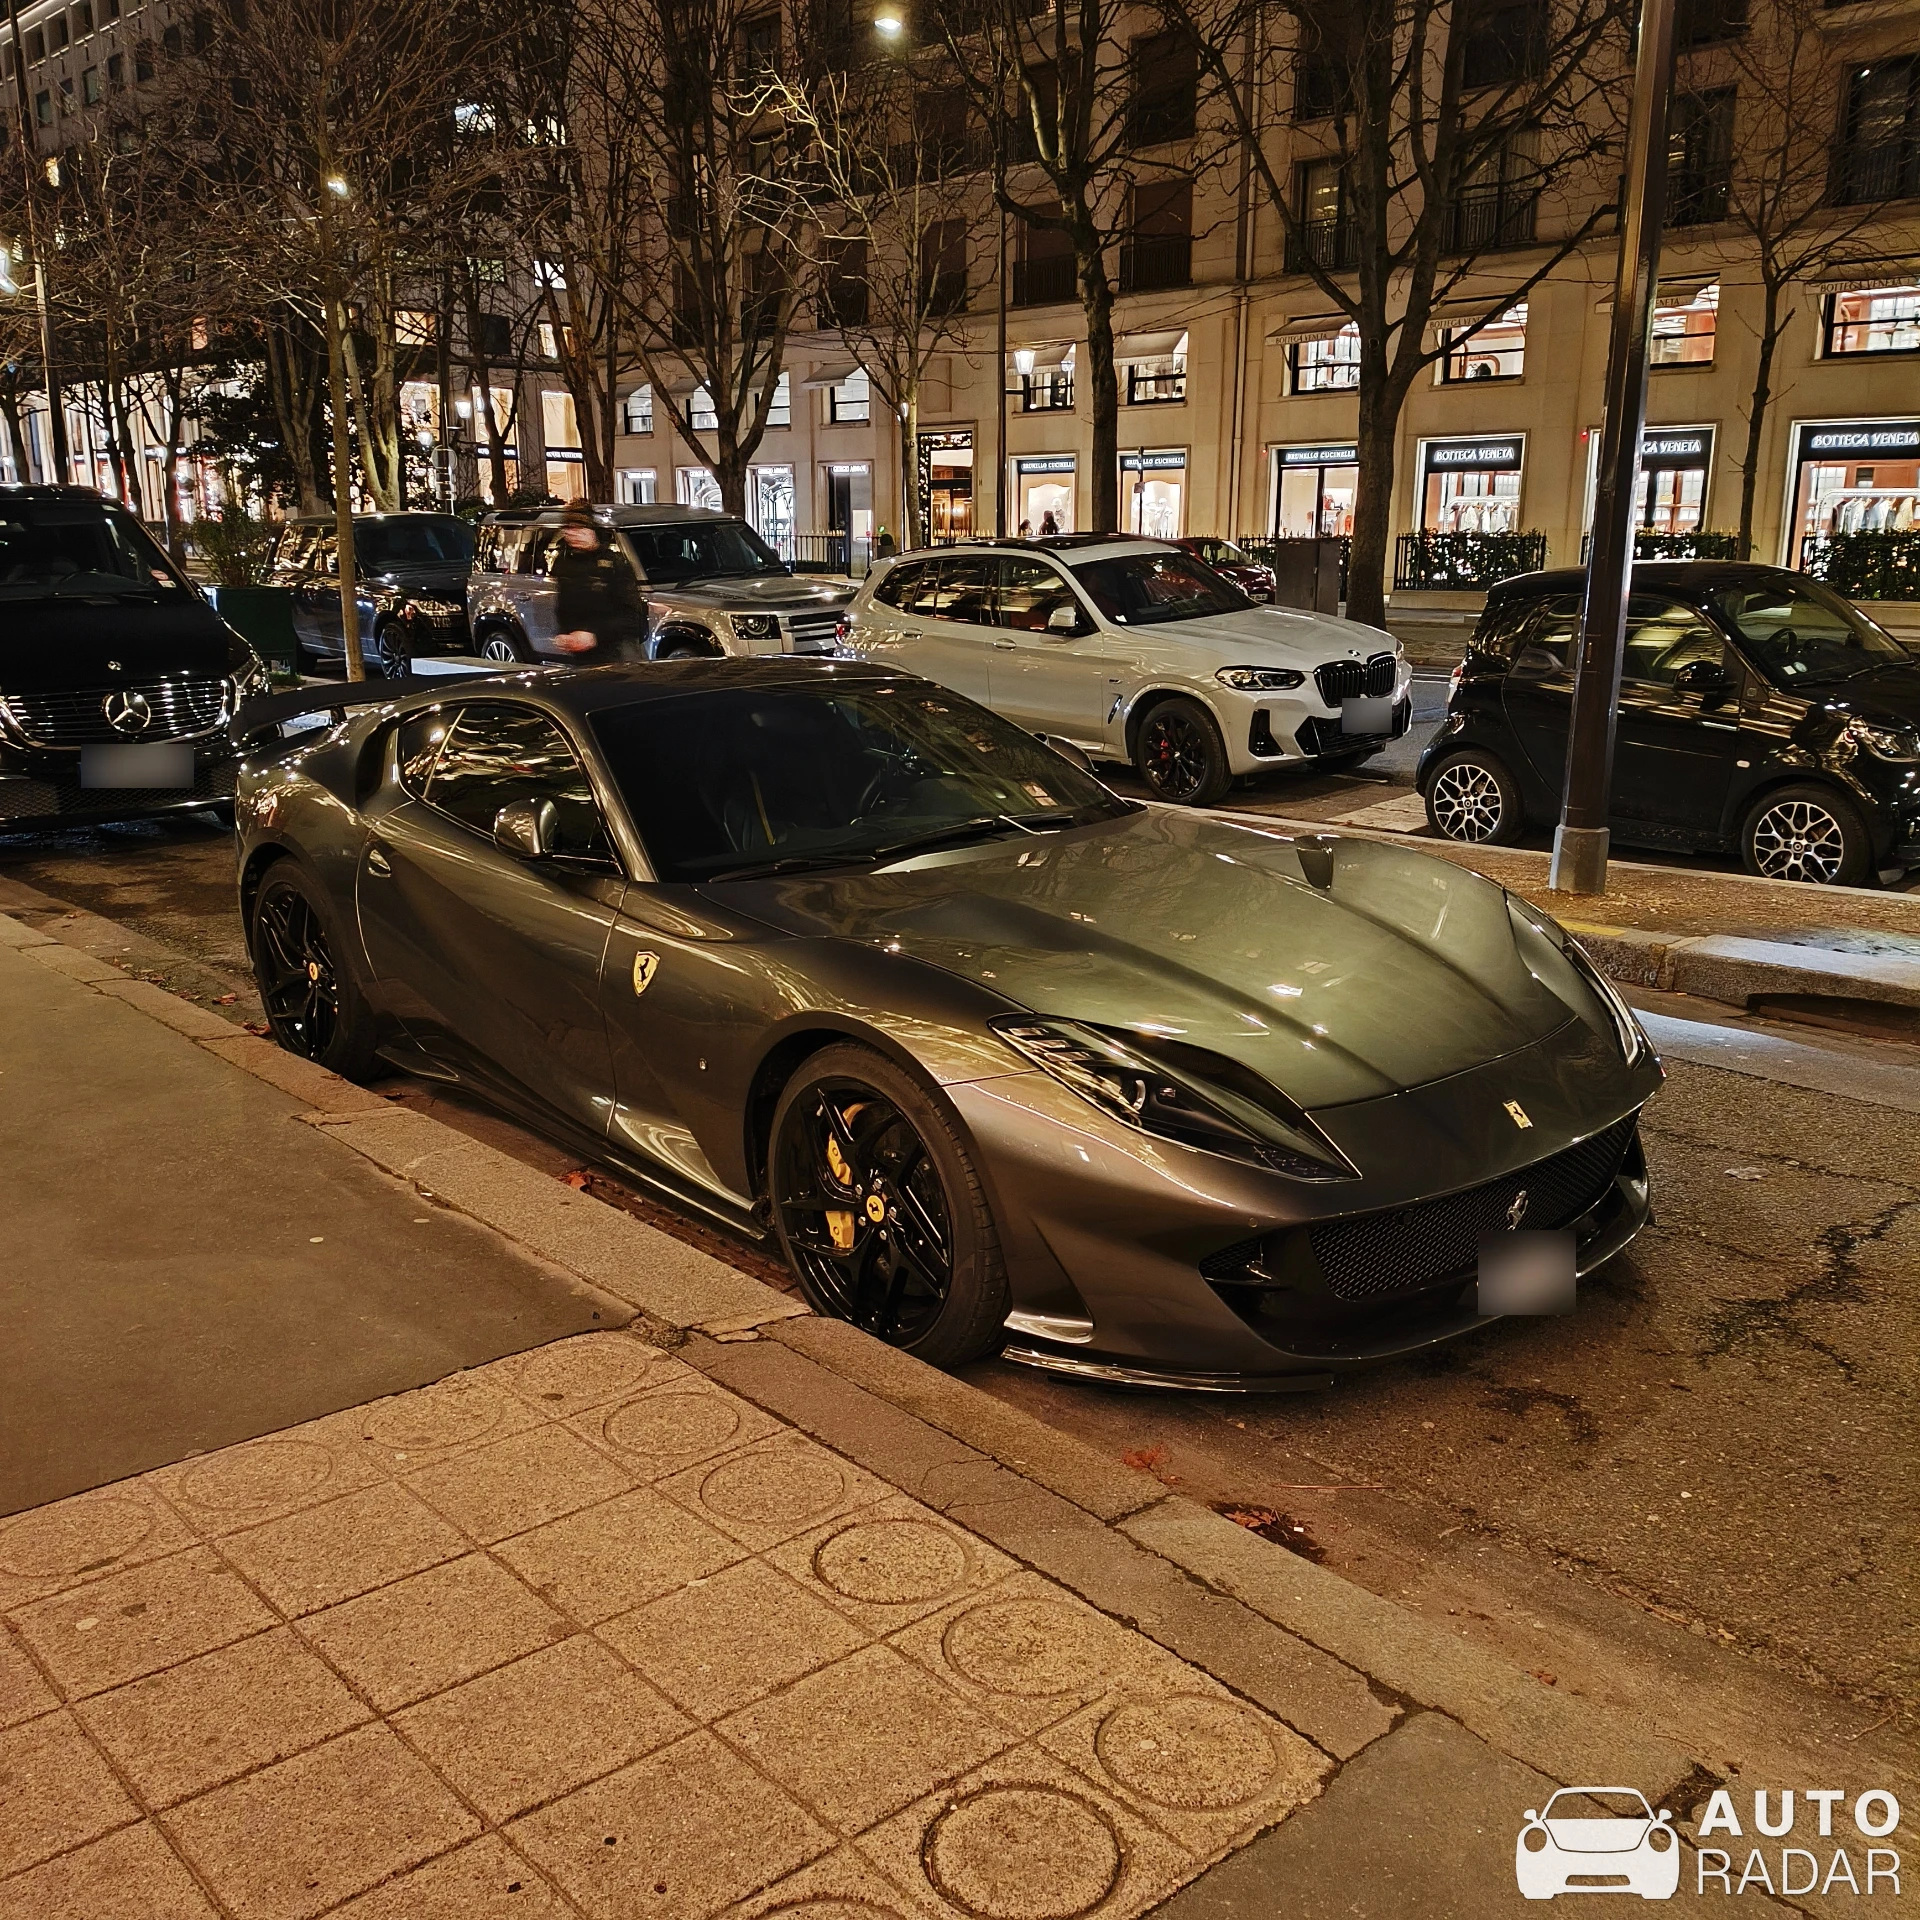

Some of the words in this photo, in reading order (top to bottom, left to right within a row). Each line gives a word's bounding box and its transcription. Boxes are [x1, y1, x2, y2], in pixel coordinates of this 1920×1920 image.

[1656, 298, 1680, 307] ENETA
[1660, 439, 1701, 453] VENETA
[1811, 433, 1869, 448] BOTTEGA
[1871, 431, 1920, 447] VENETA
[1434, 448, 1477, 462] BOTTEGA
[1478, 447, 1514, 460] VENETA
